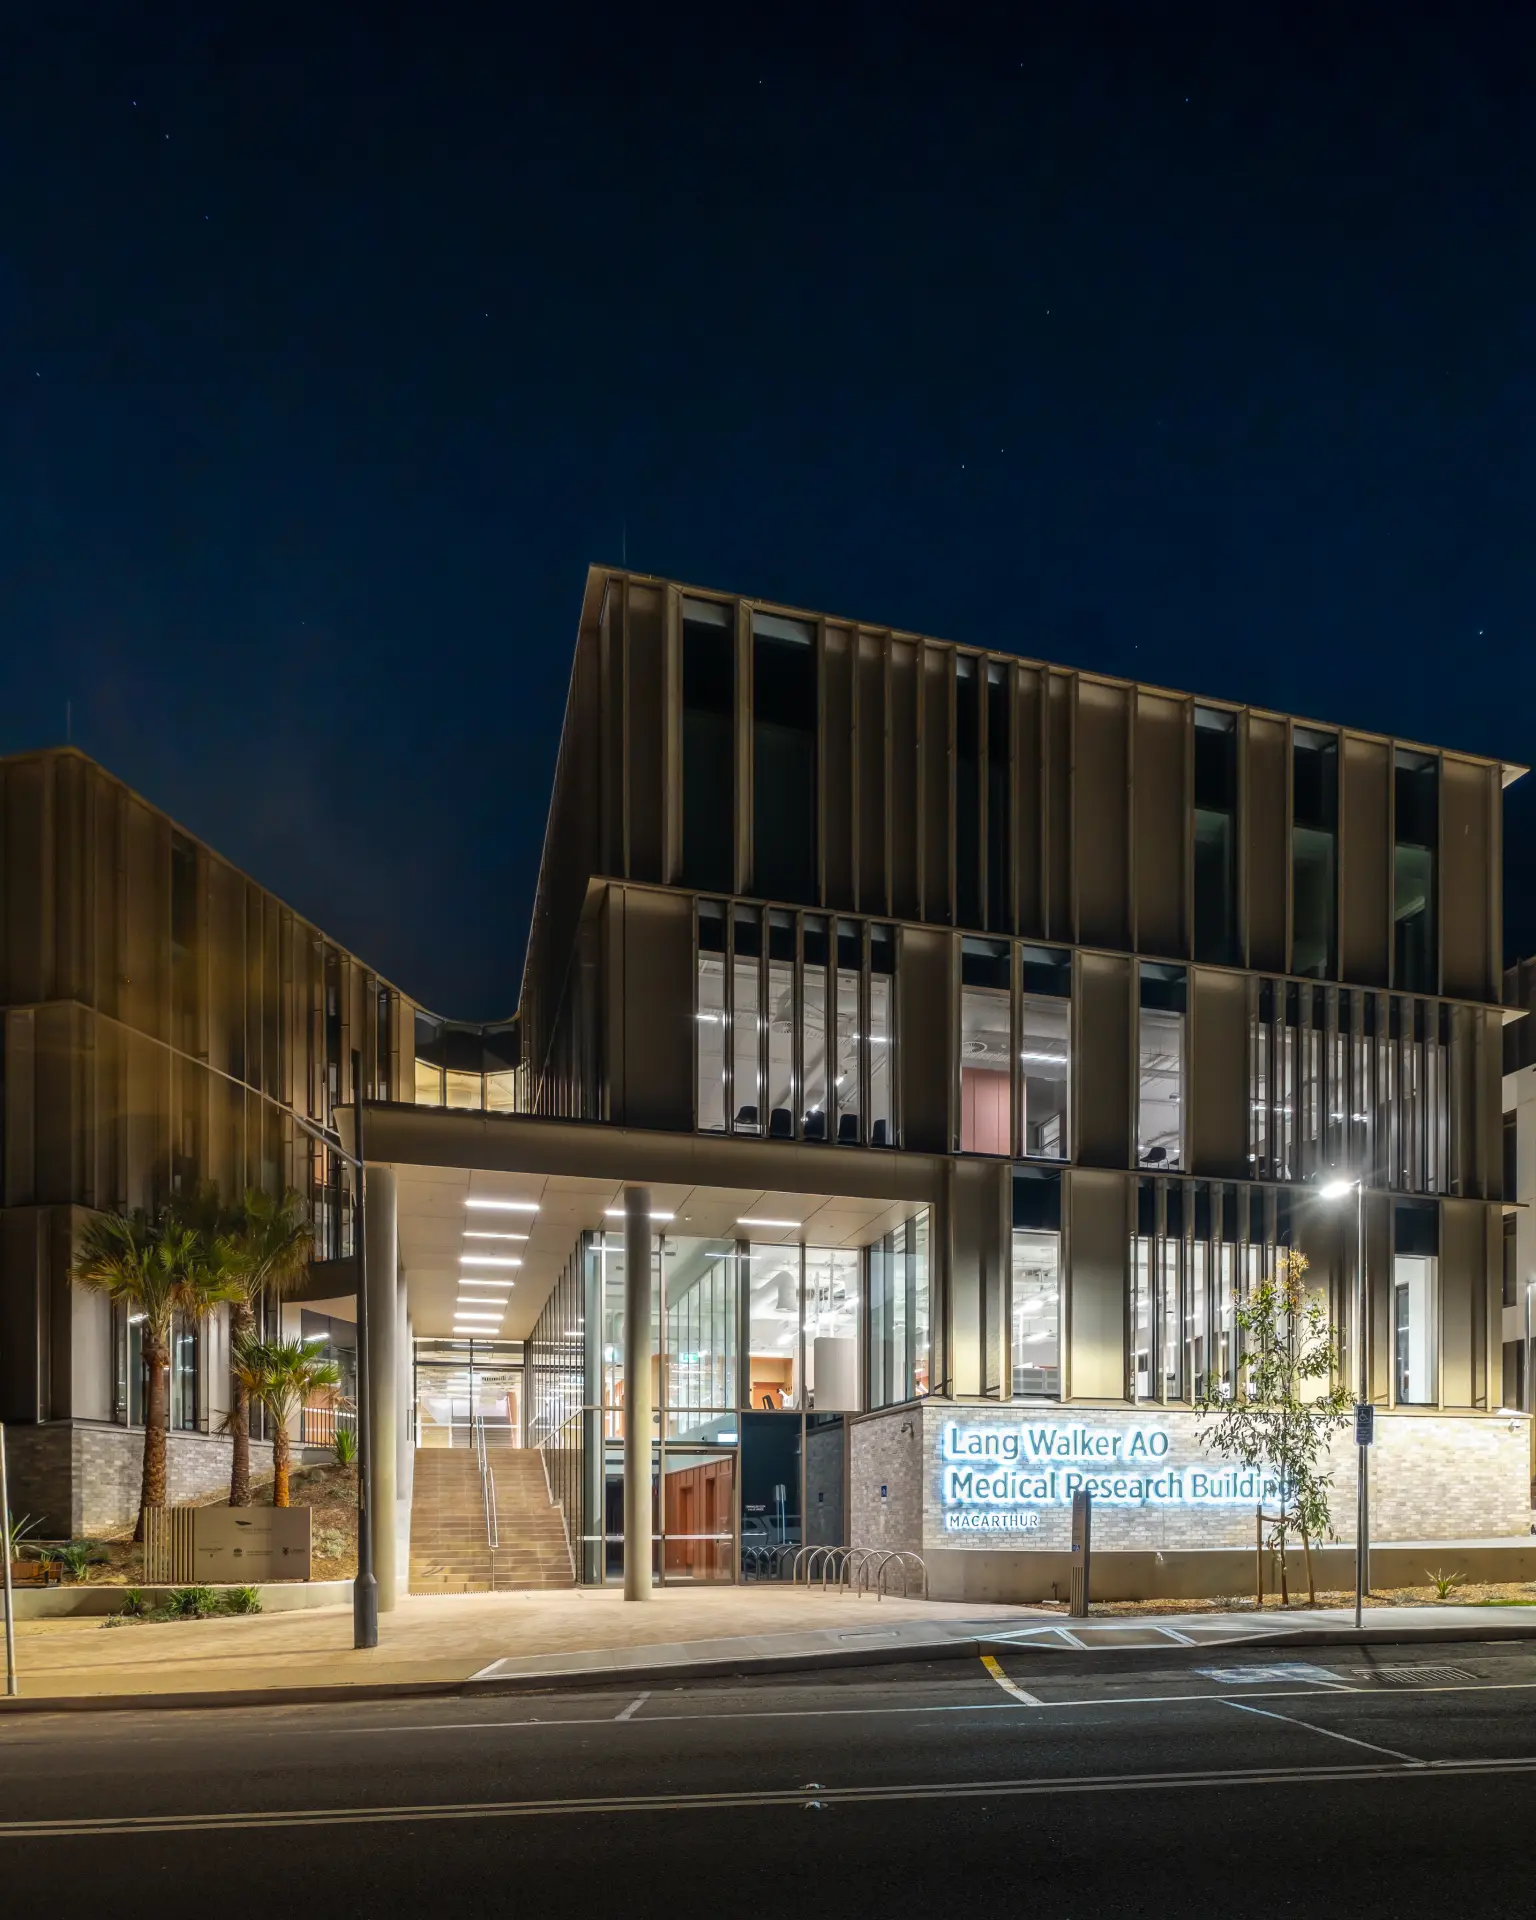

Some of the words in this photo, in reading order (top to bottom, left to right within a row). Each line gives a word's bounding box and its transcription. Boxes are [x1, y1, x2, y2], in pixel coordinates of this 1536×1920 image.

[951, 1428, 1018, 1459] Lang
[1029, 1428, 1121, 1456] Walker
[1129, 1431, 1168, 1456] AO
[951, 1472, 1055, 1499] Medical
[1066, 1472, 1182, 1499] Research
[949, 1515, 1038, 1527] MACARTHUR
